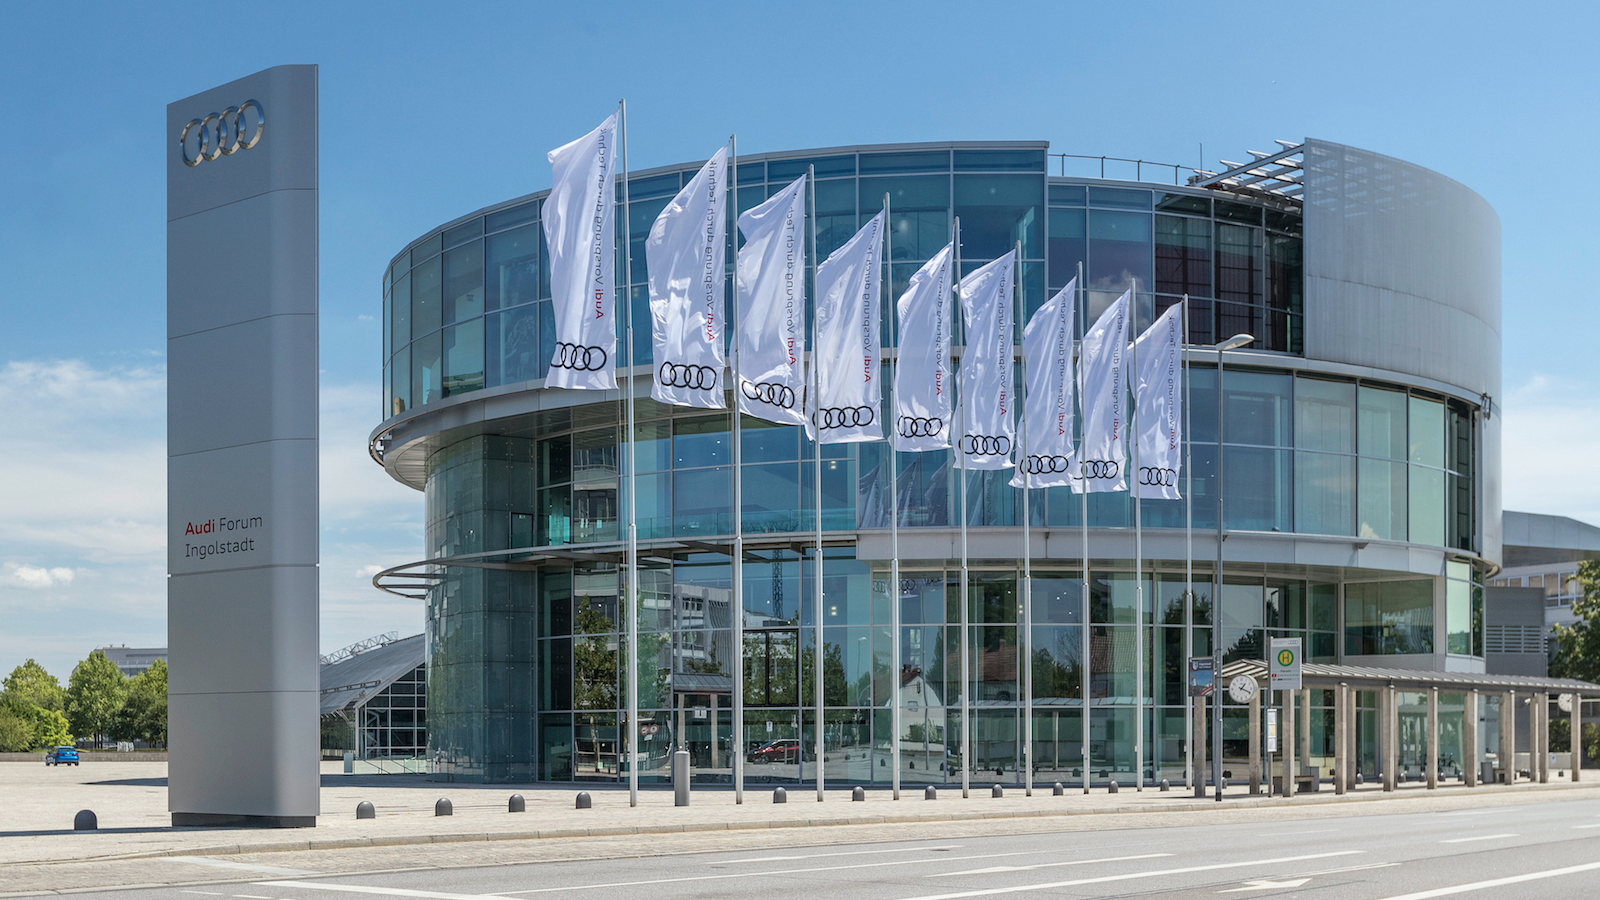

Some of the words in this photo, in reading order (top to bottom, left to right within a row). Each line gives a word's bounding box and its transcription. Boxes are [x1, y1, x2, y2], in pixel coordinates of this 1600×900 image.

[184, 519, 215, 536] Audi
[219, 516, 263, 532] Forum
[185, 537, 255, 560] Ingolstadt
[1282, 653, 1290, 663] H
